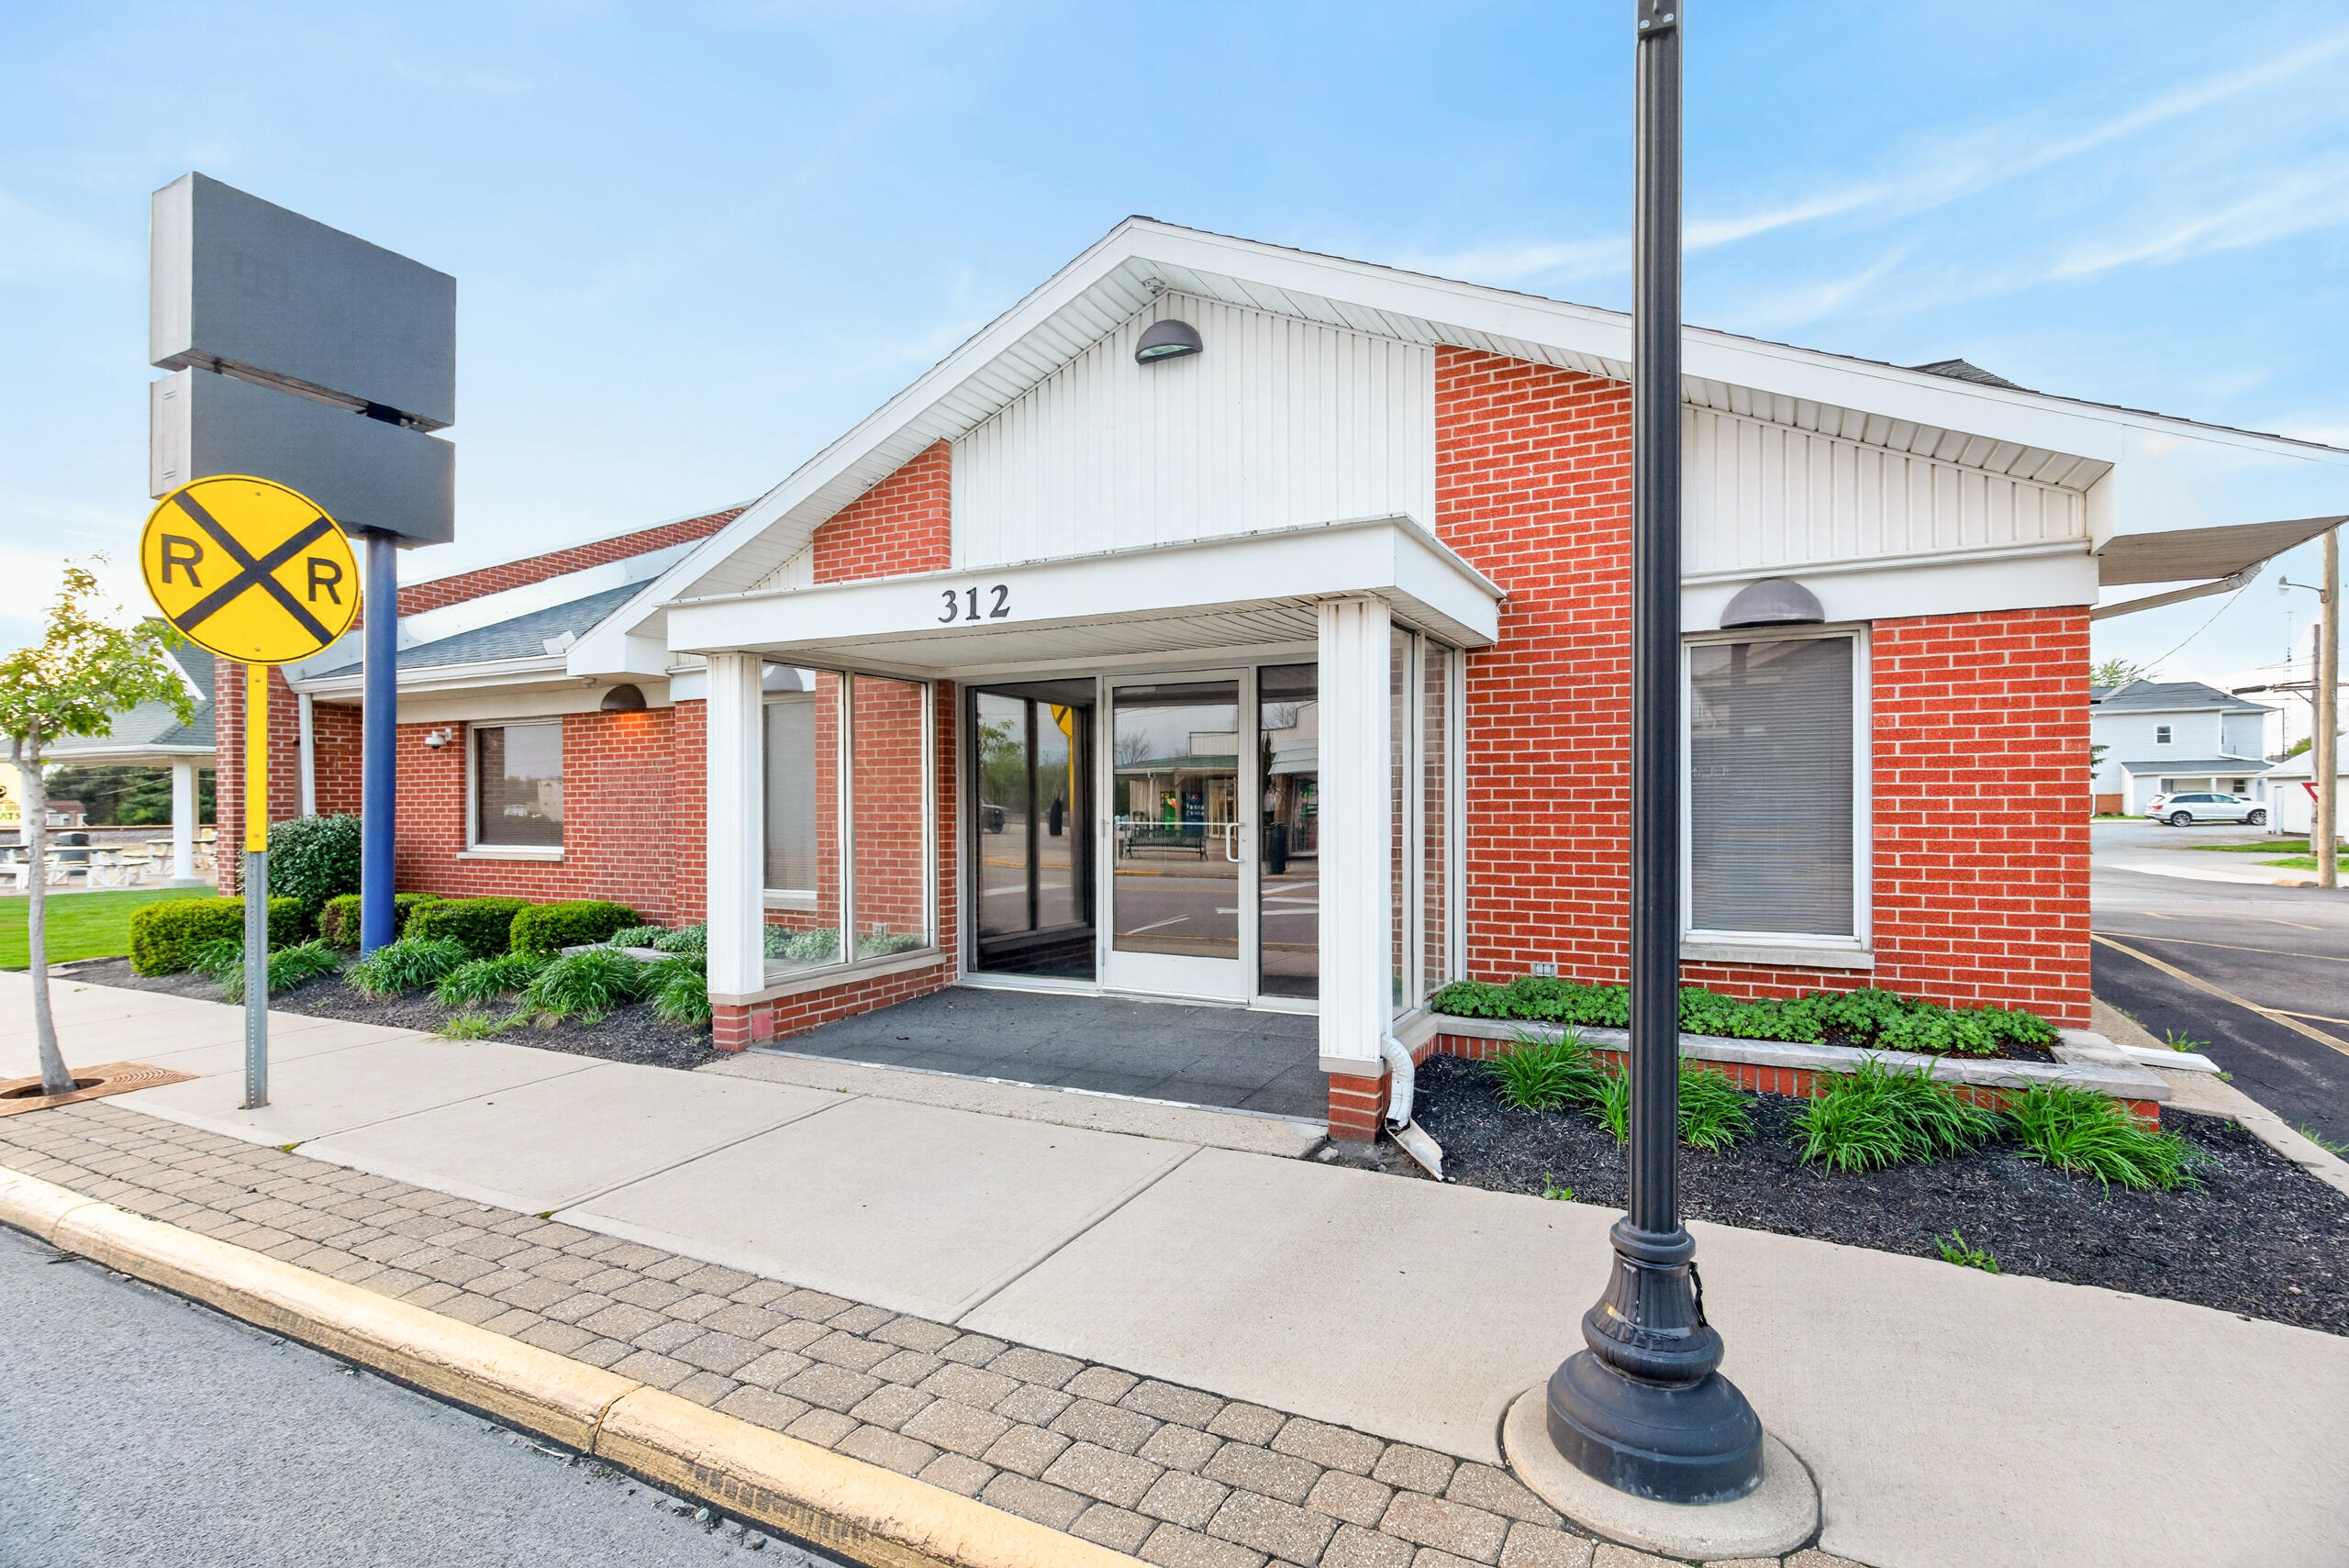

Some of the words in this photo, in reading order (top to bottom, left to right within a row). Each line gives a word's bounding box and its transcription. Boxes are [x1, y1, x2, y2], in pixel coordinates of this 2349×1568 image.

[161, 533, 204, 588] R
[307, 557, 342, 605] R
[938, 584, 1010, 623] 312
